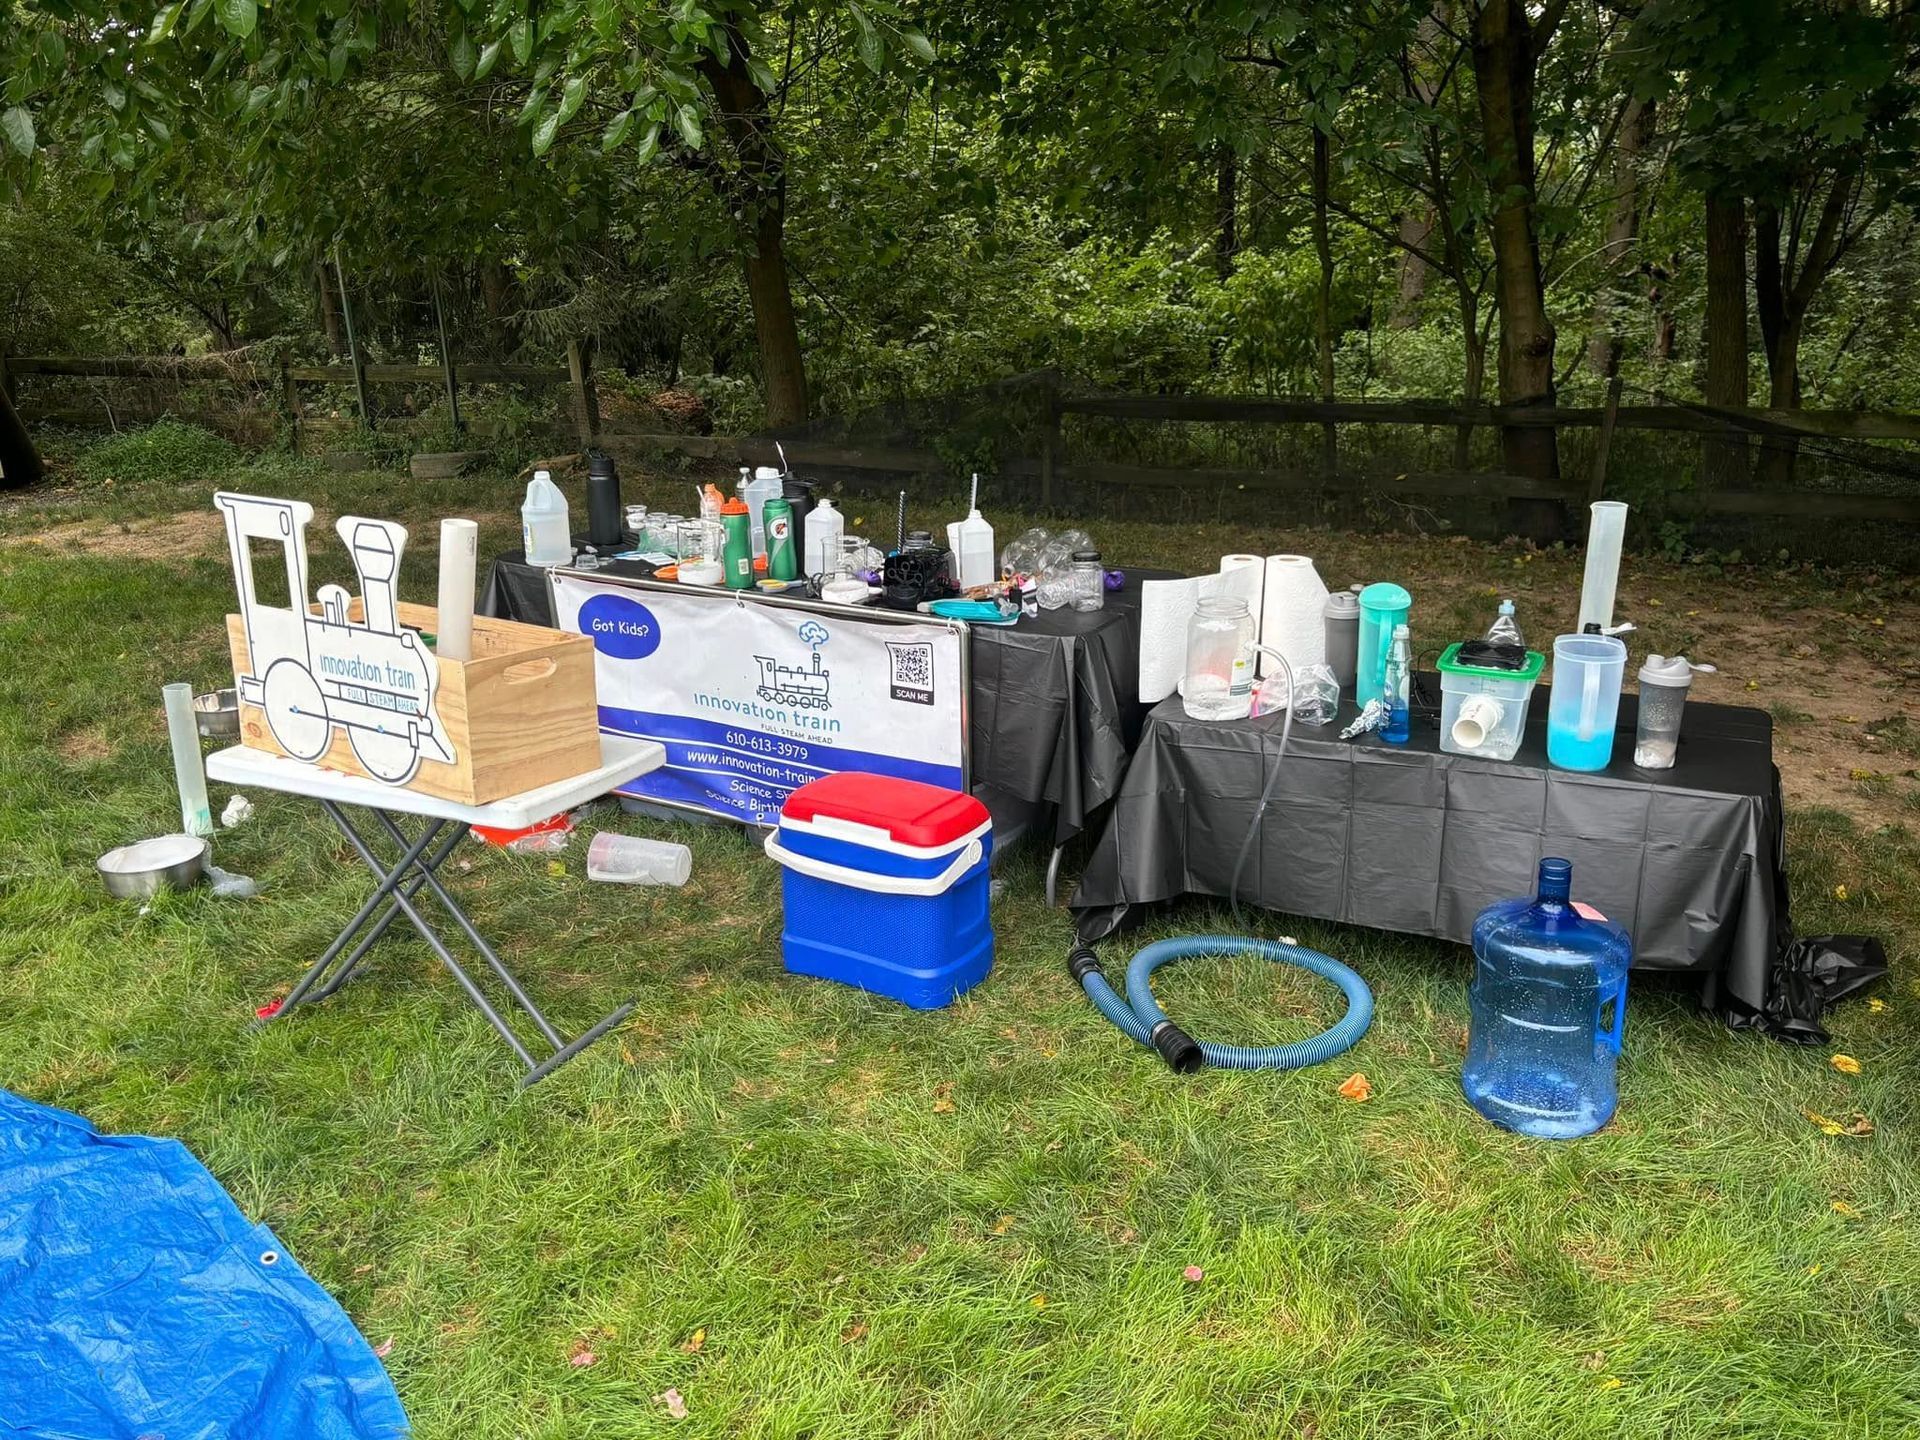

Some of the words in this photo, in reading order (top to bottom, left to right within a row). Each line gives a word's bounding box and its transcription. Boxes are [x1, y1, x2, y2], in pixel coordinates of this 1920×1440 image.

[592, 618, 614, 632] Got
[618, 621, 648, 637] Kids?
[319, 654, 382, 683] innovation
[385, 660, 416, 690] train
[347, 688, 364, 701] FULL
[369, 692, 394, 707] STEAM
[896, 690, 915, 700] SCAN
[917, 692, 928, 702] ME
[694, 693, 787, 723] innovation
[793, 711, 841, 732] train
[761, 723, 778, 734] FULL
[781, 728, 805, 740] STEAM
[807, 734, 833, 745] AHEAD
[726, 731, 808, 760] 610-613-3979
[730, 780, 772, 798] Science
